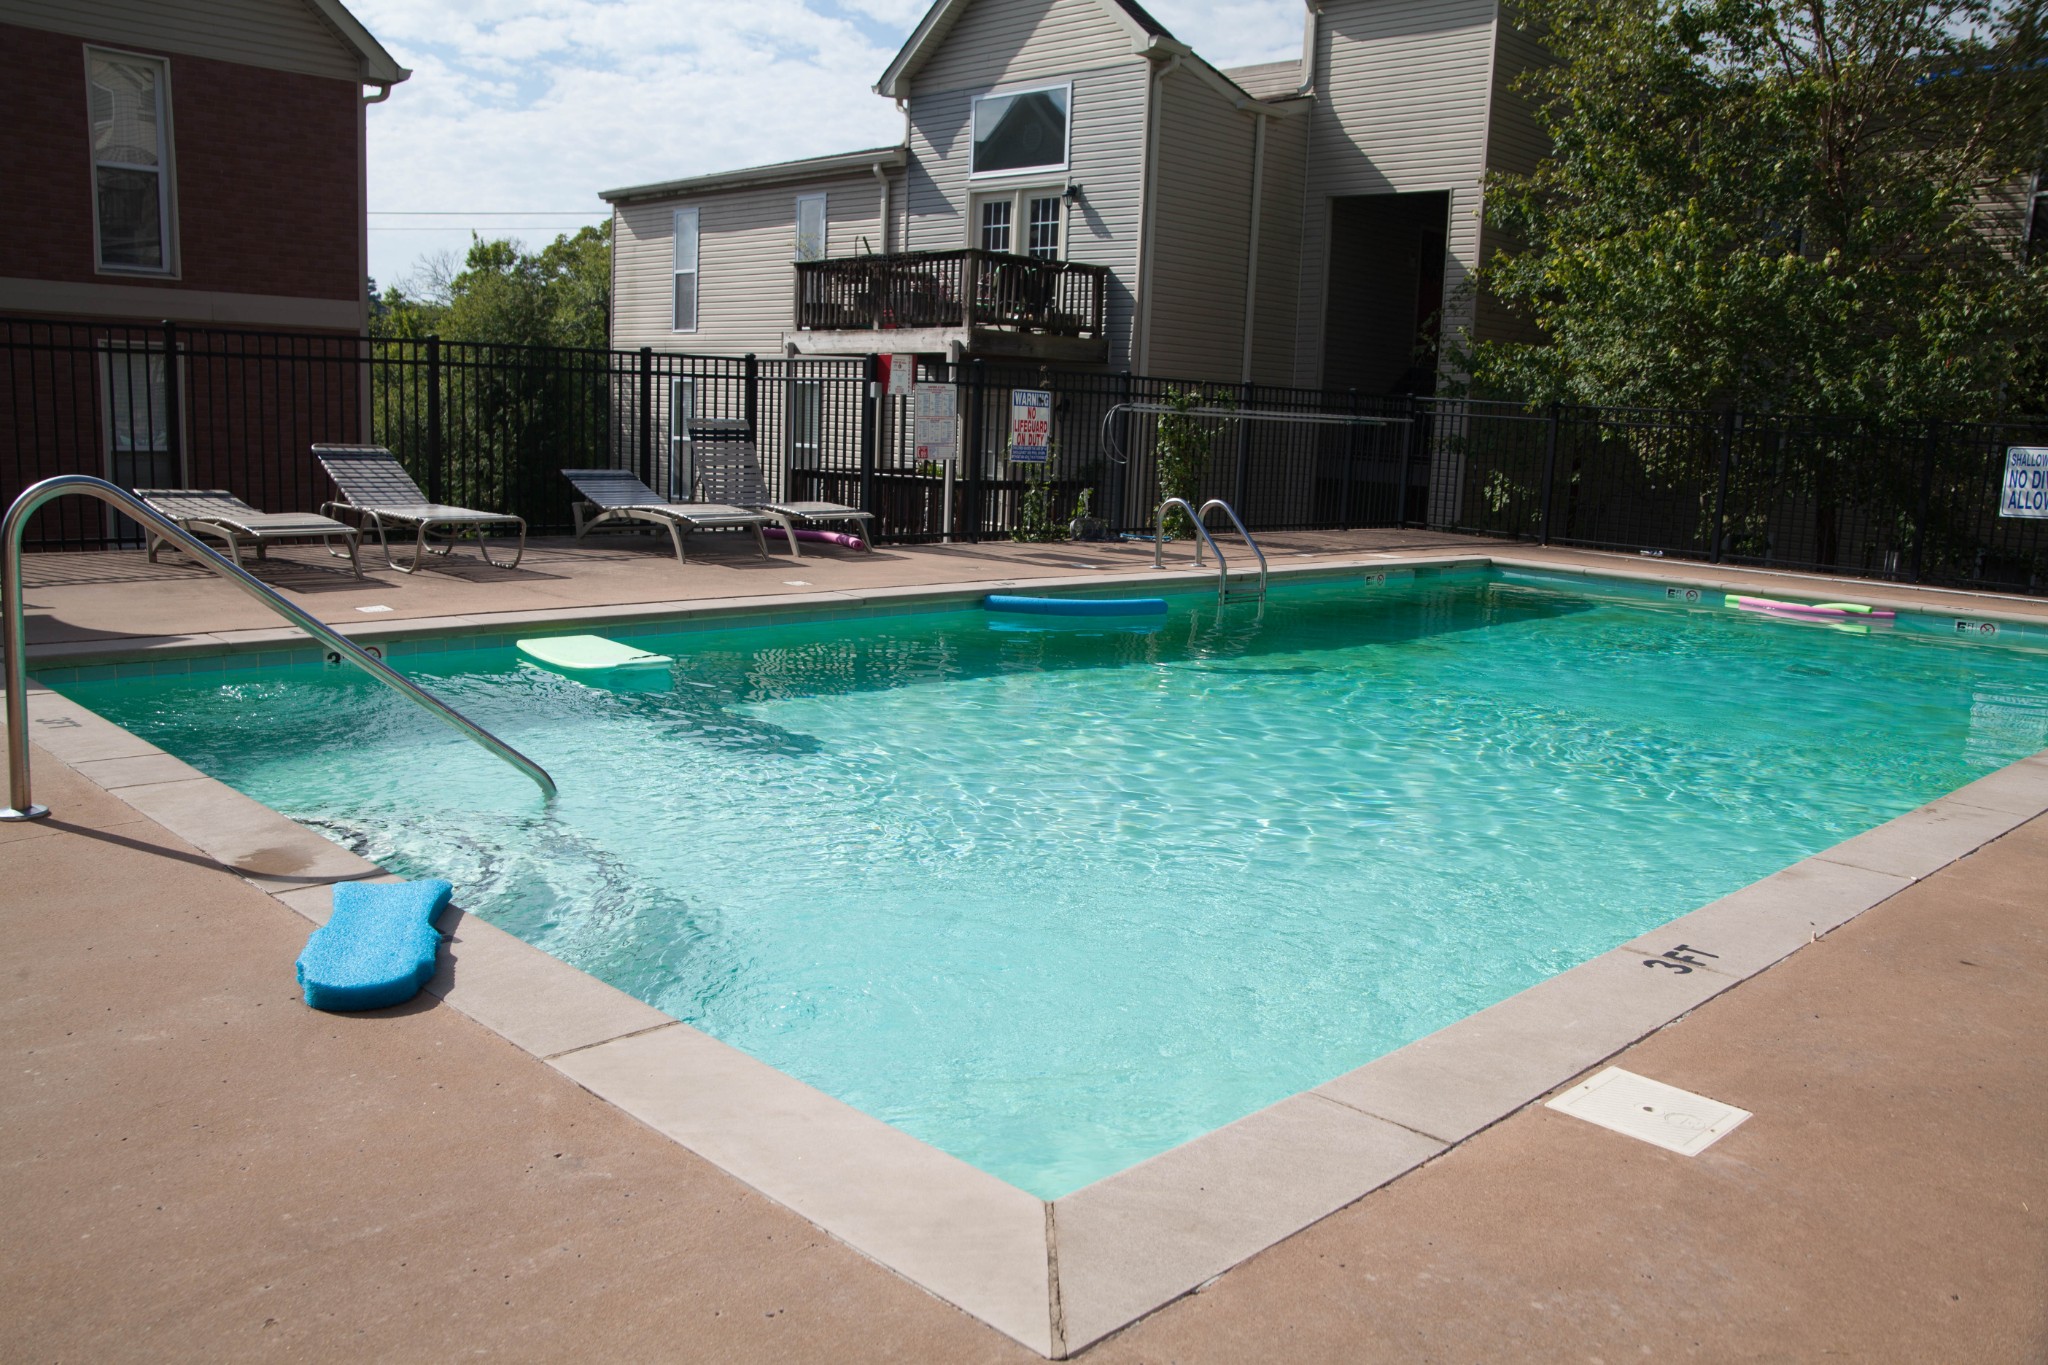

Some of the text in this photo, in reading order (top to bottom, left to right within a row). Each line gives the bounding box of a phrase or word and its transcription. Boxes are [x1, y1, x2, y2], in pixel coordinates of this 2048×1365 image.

[1028, 407, 1037, 420] NO
[1014, 419, 1048, 433] LIFEGUARD
[1017, 433, 1045, 446] ON DUTY
[2009, 470, 2048, 489] NO DI
